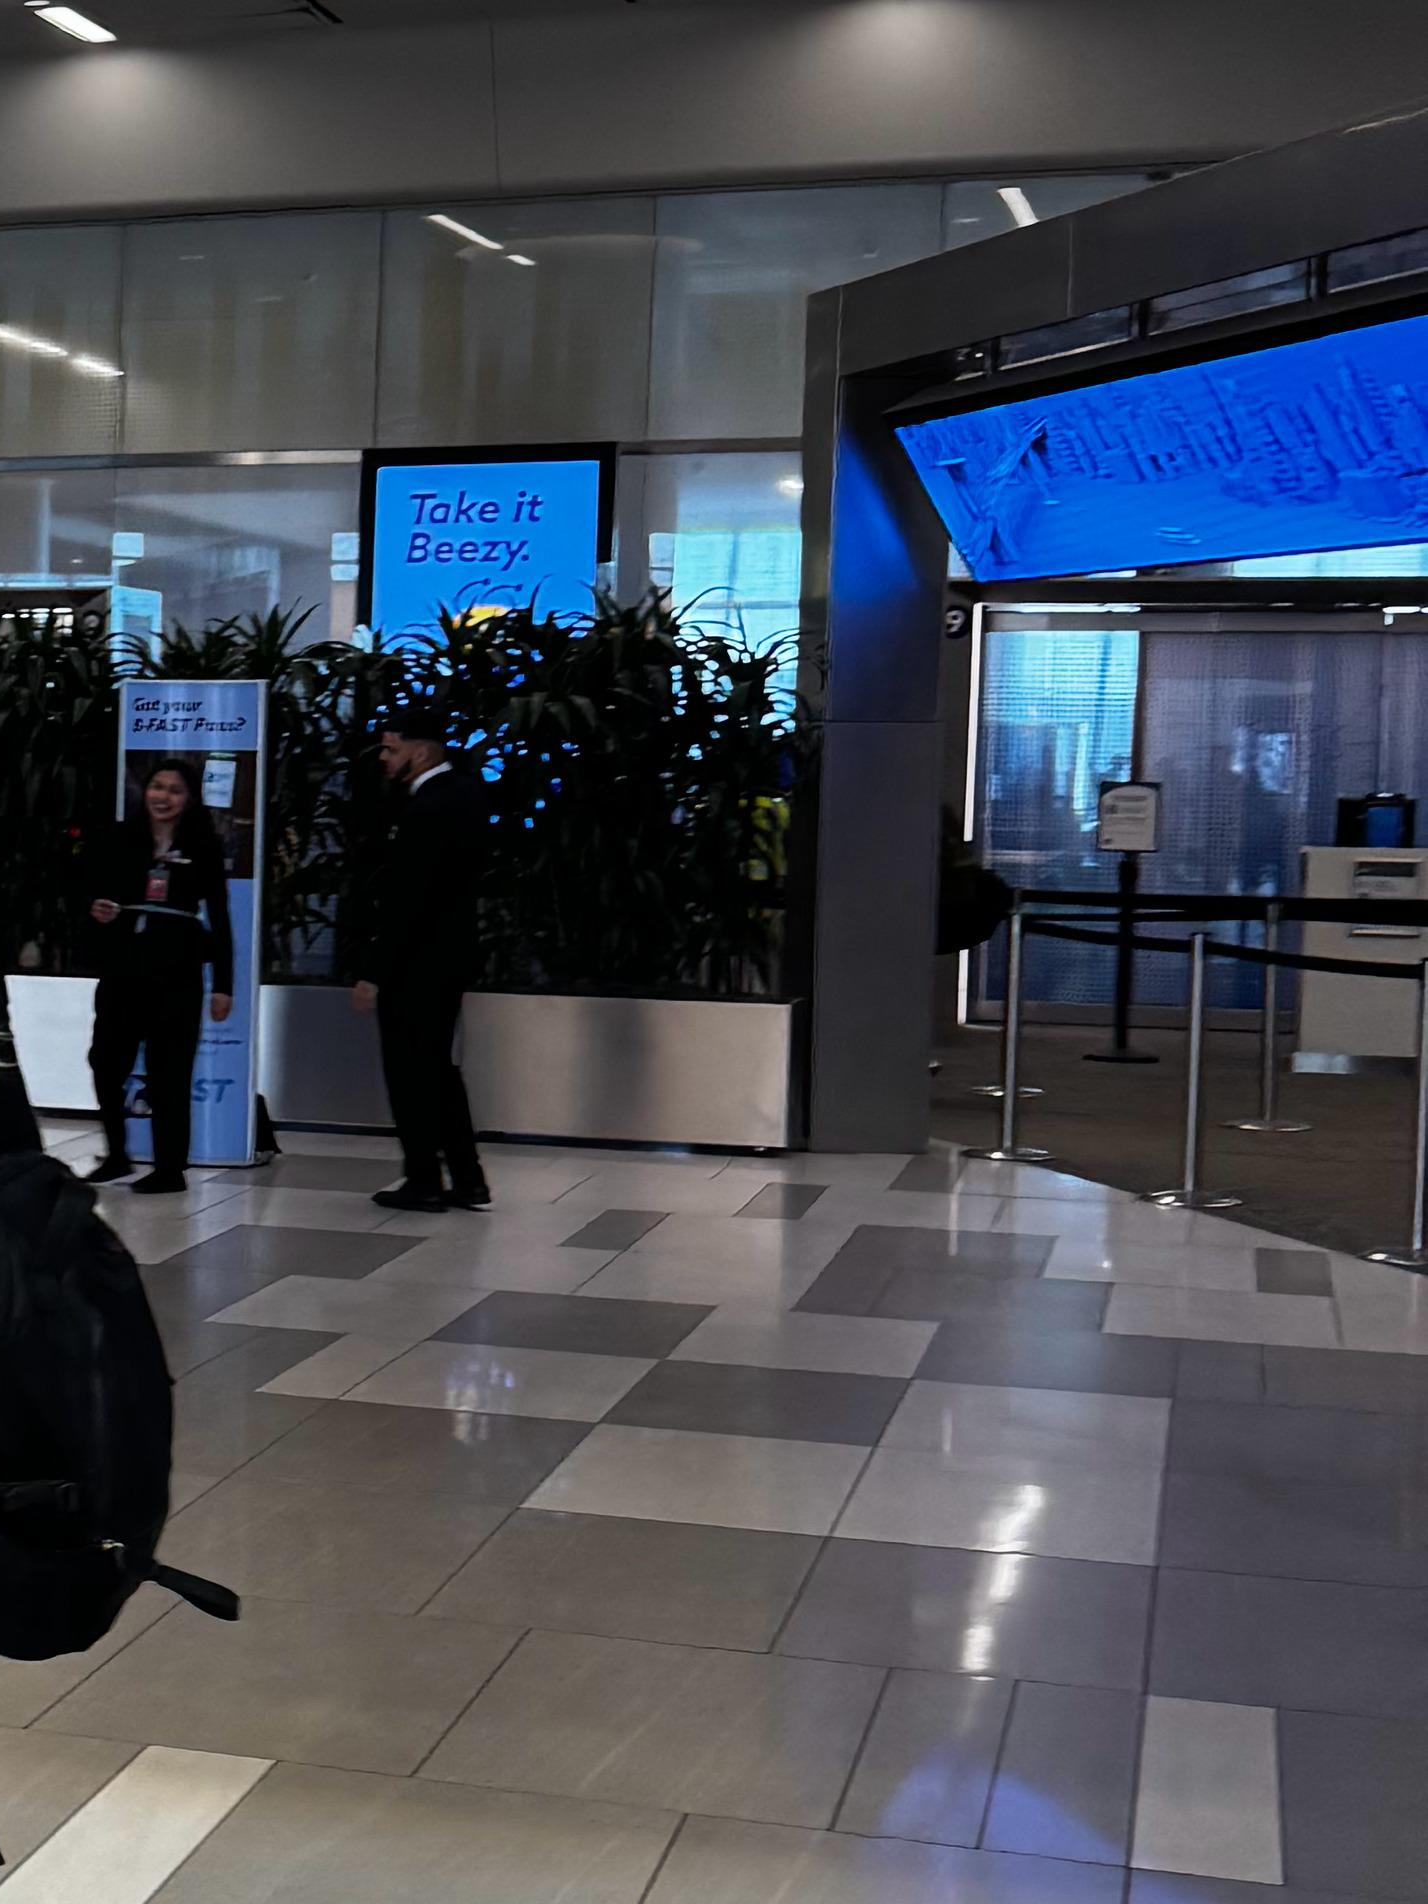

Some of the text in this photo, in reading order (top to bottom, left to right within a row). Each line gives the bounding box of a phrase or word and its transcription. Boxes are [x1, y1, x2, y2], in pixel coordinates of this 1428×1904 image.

[409, 490, 544, 525] Take it
[406, 532, 530, 572] Beezy.
[945, 608, 965, 634] 9
